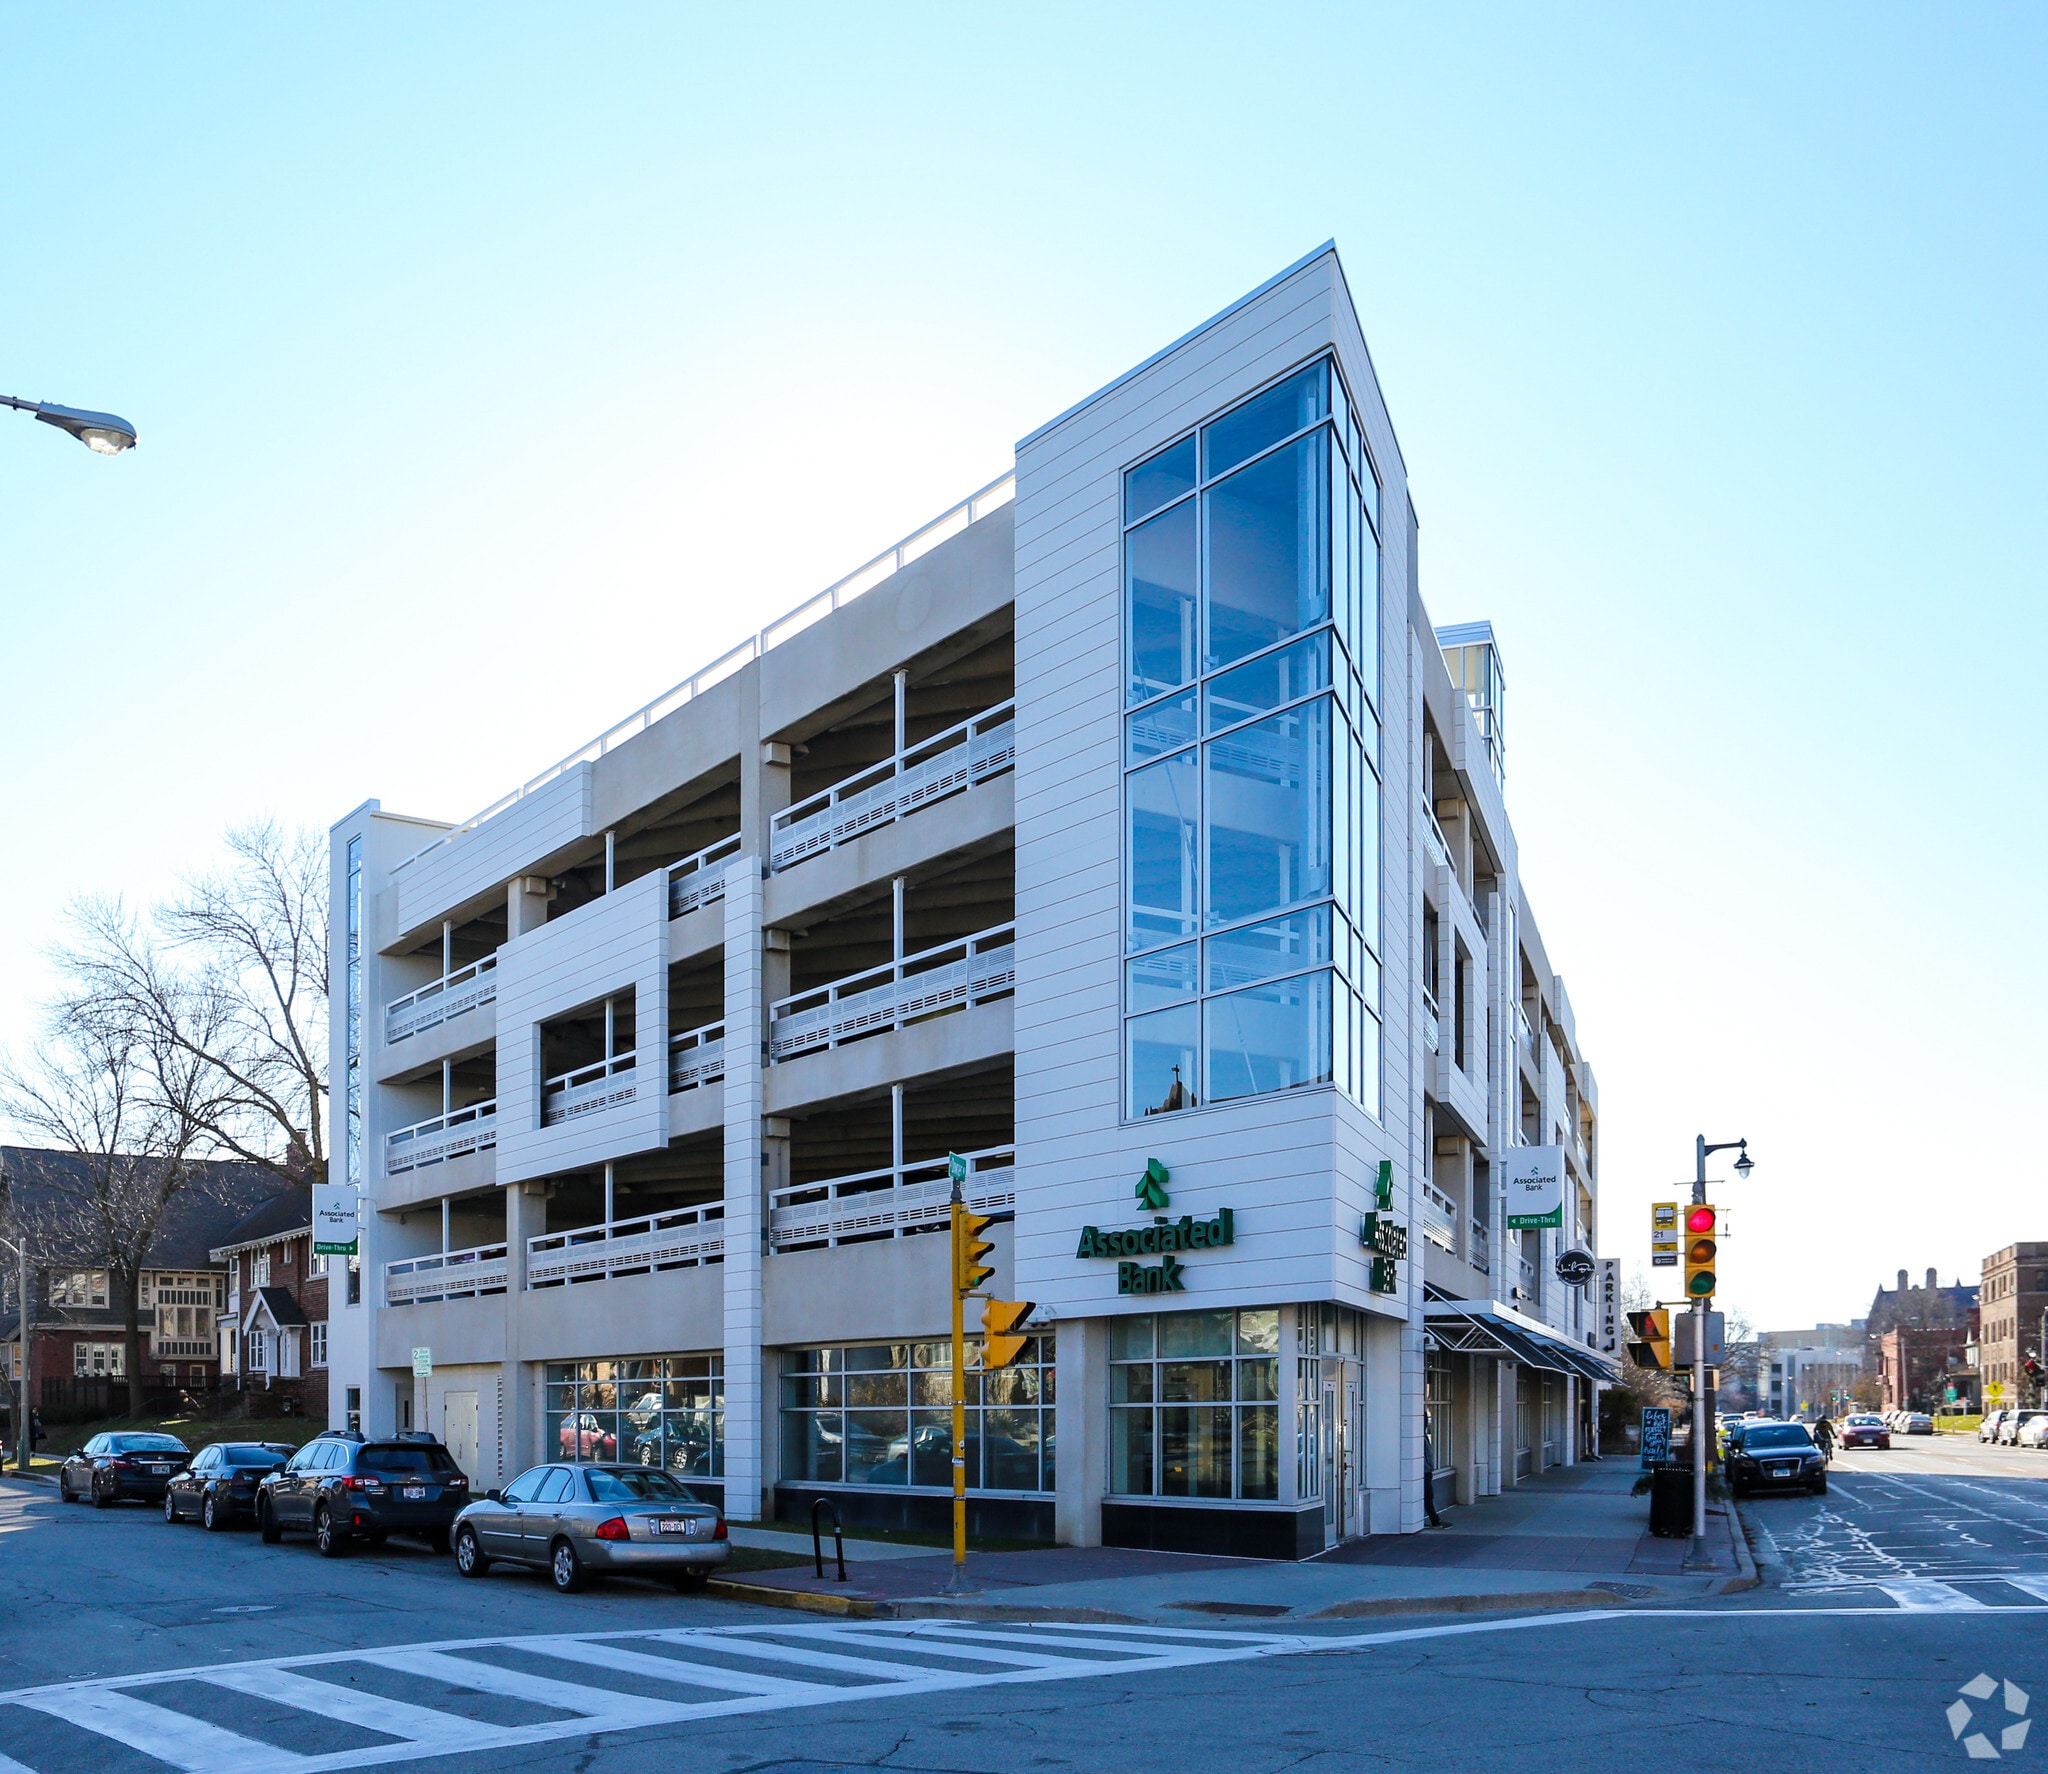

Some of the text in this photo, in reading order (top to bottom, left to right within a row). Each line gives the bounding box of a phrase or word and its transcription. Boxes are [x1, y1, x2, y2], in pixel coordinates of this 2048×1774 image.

[1513, 1176, 1556, 1184] Associated
[319, 1210, 355, 1218] Associated
[1519, 1216, 1556, 1225] Drive-Thru
[1076, 1208, 1234, 1259] Associated
[316, 1243, 347, 1251] Drive-Thru
[1118, 1255, 1185, 1294] Bank
[1605, 1261, 1615, 1335] PARKING
